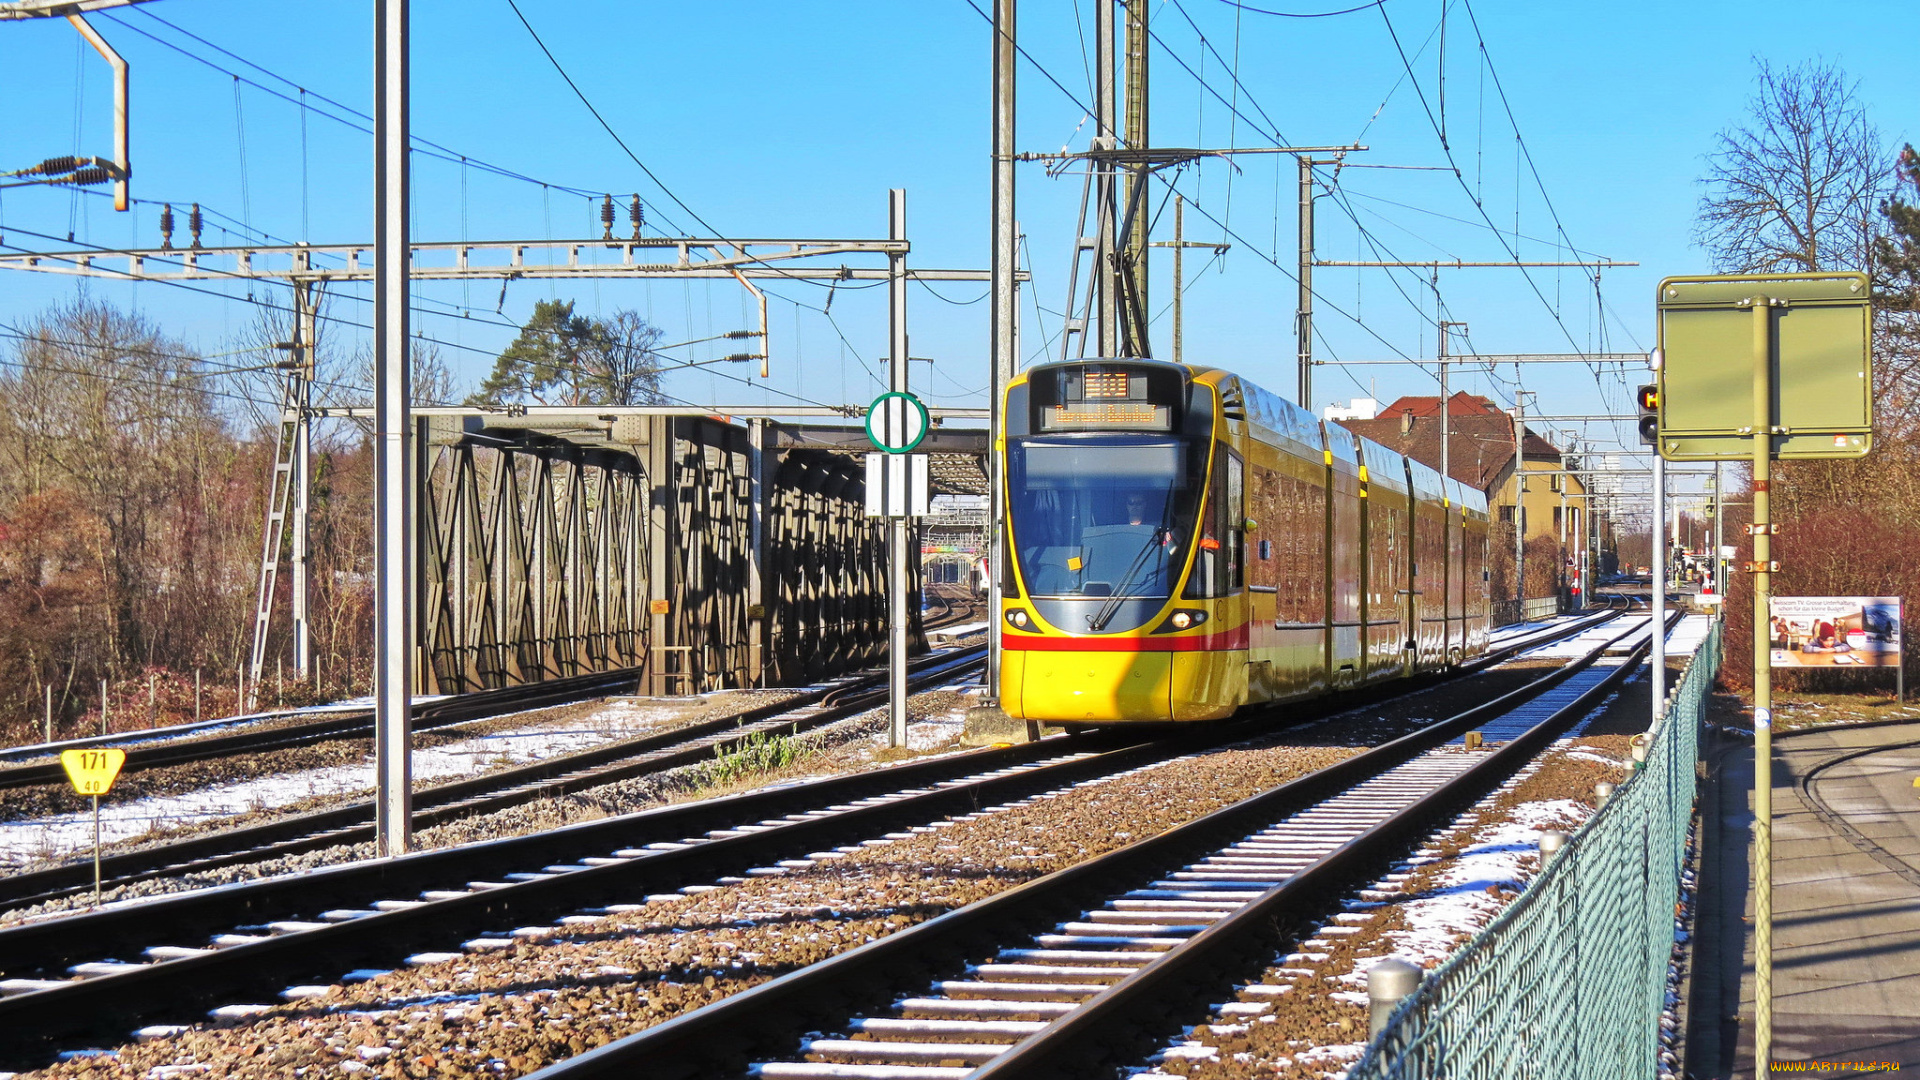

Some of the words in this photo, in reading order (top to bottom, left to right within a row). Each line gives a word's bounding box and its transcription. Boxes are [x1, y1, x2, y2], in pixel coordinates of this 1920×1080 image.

[1107, 404, 1156, 422] Bahnhof
[81, 752, 107, 769] 171
[85, 781, 100, 792] 40
